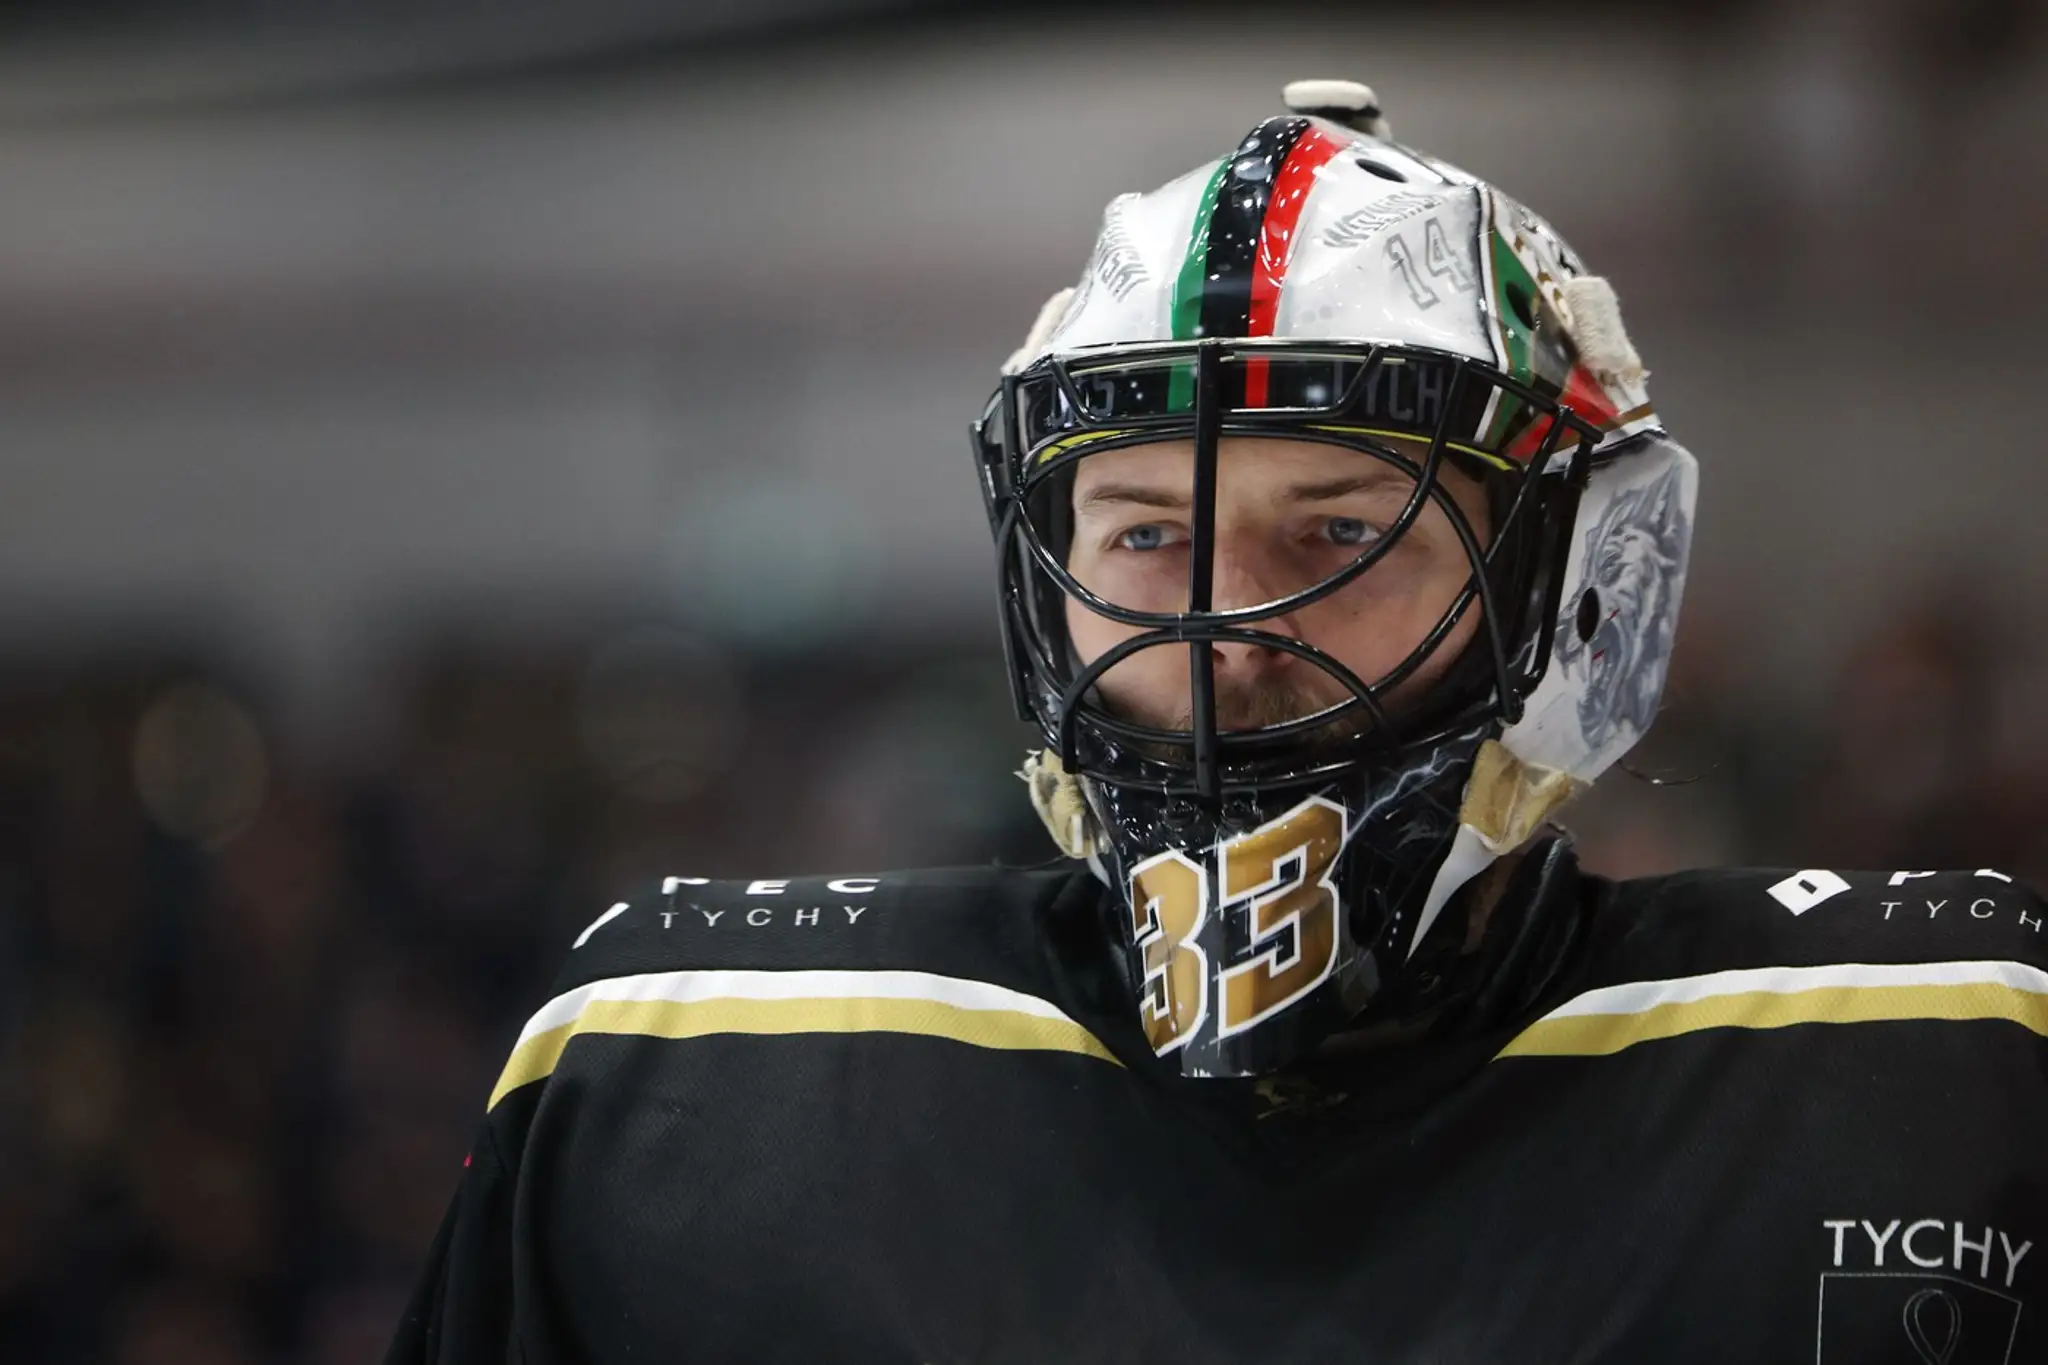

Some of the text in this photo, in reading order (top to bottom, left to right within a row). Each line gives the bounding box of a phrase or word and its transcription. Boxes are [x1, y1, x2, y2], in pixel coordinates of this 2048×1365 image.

[1384, 216, 1475, 311] 14
[660, 905, 867, 929] TYCHY
[1128, 797, 1349, 1058] 33
[1823, 1219, 2033, 1288] TYCHY
